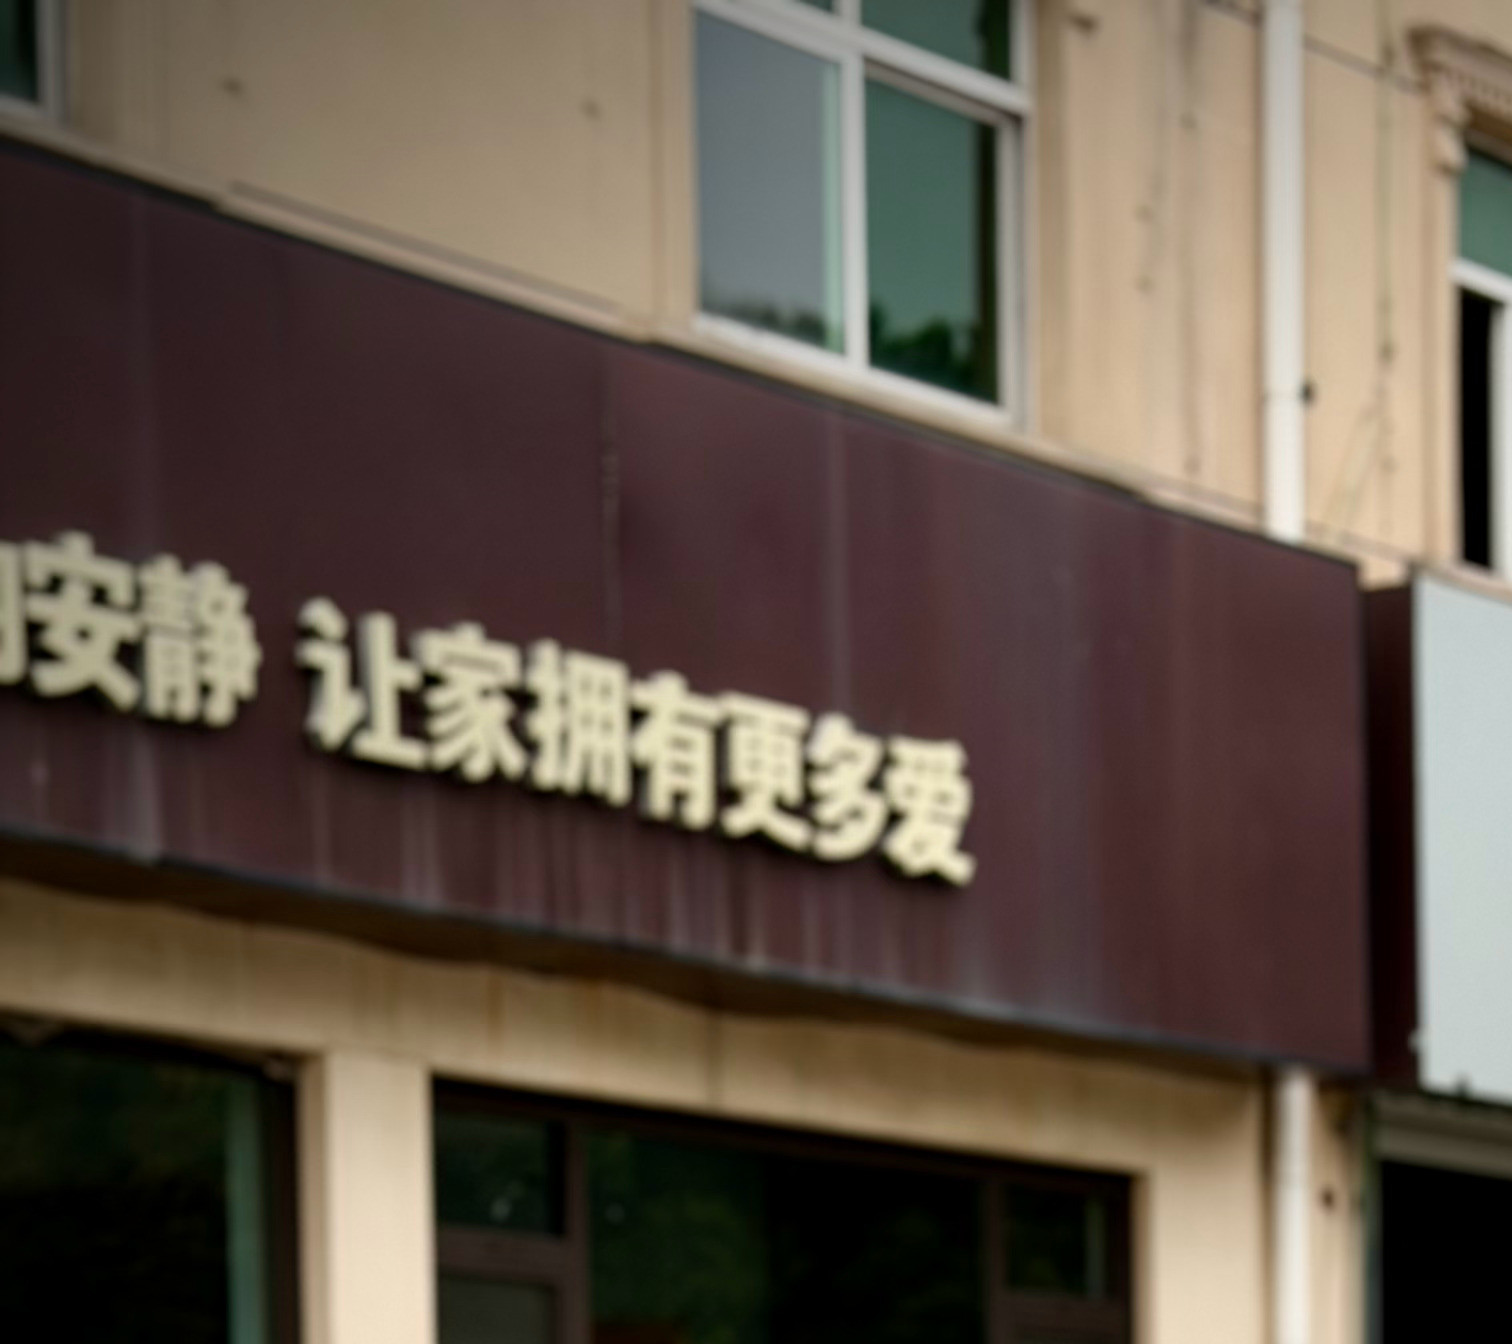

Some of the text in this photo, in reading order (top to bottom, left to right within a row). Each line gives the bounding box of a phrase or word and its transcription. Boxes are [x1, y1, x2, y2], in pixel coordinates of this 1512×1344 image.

[298, 599, 975, 884] 让家拥有更多爱
